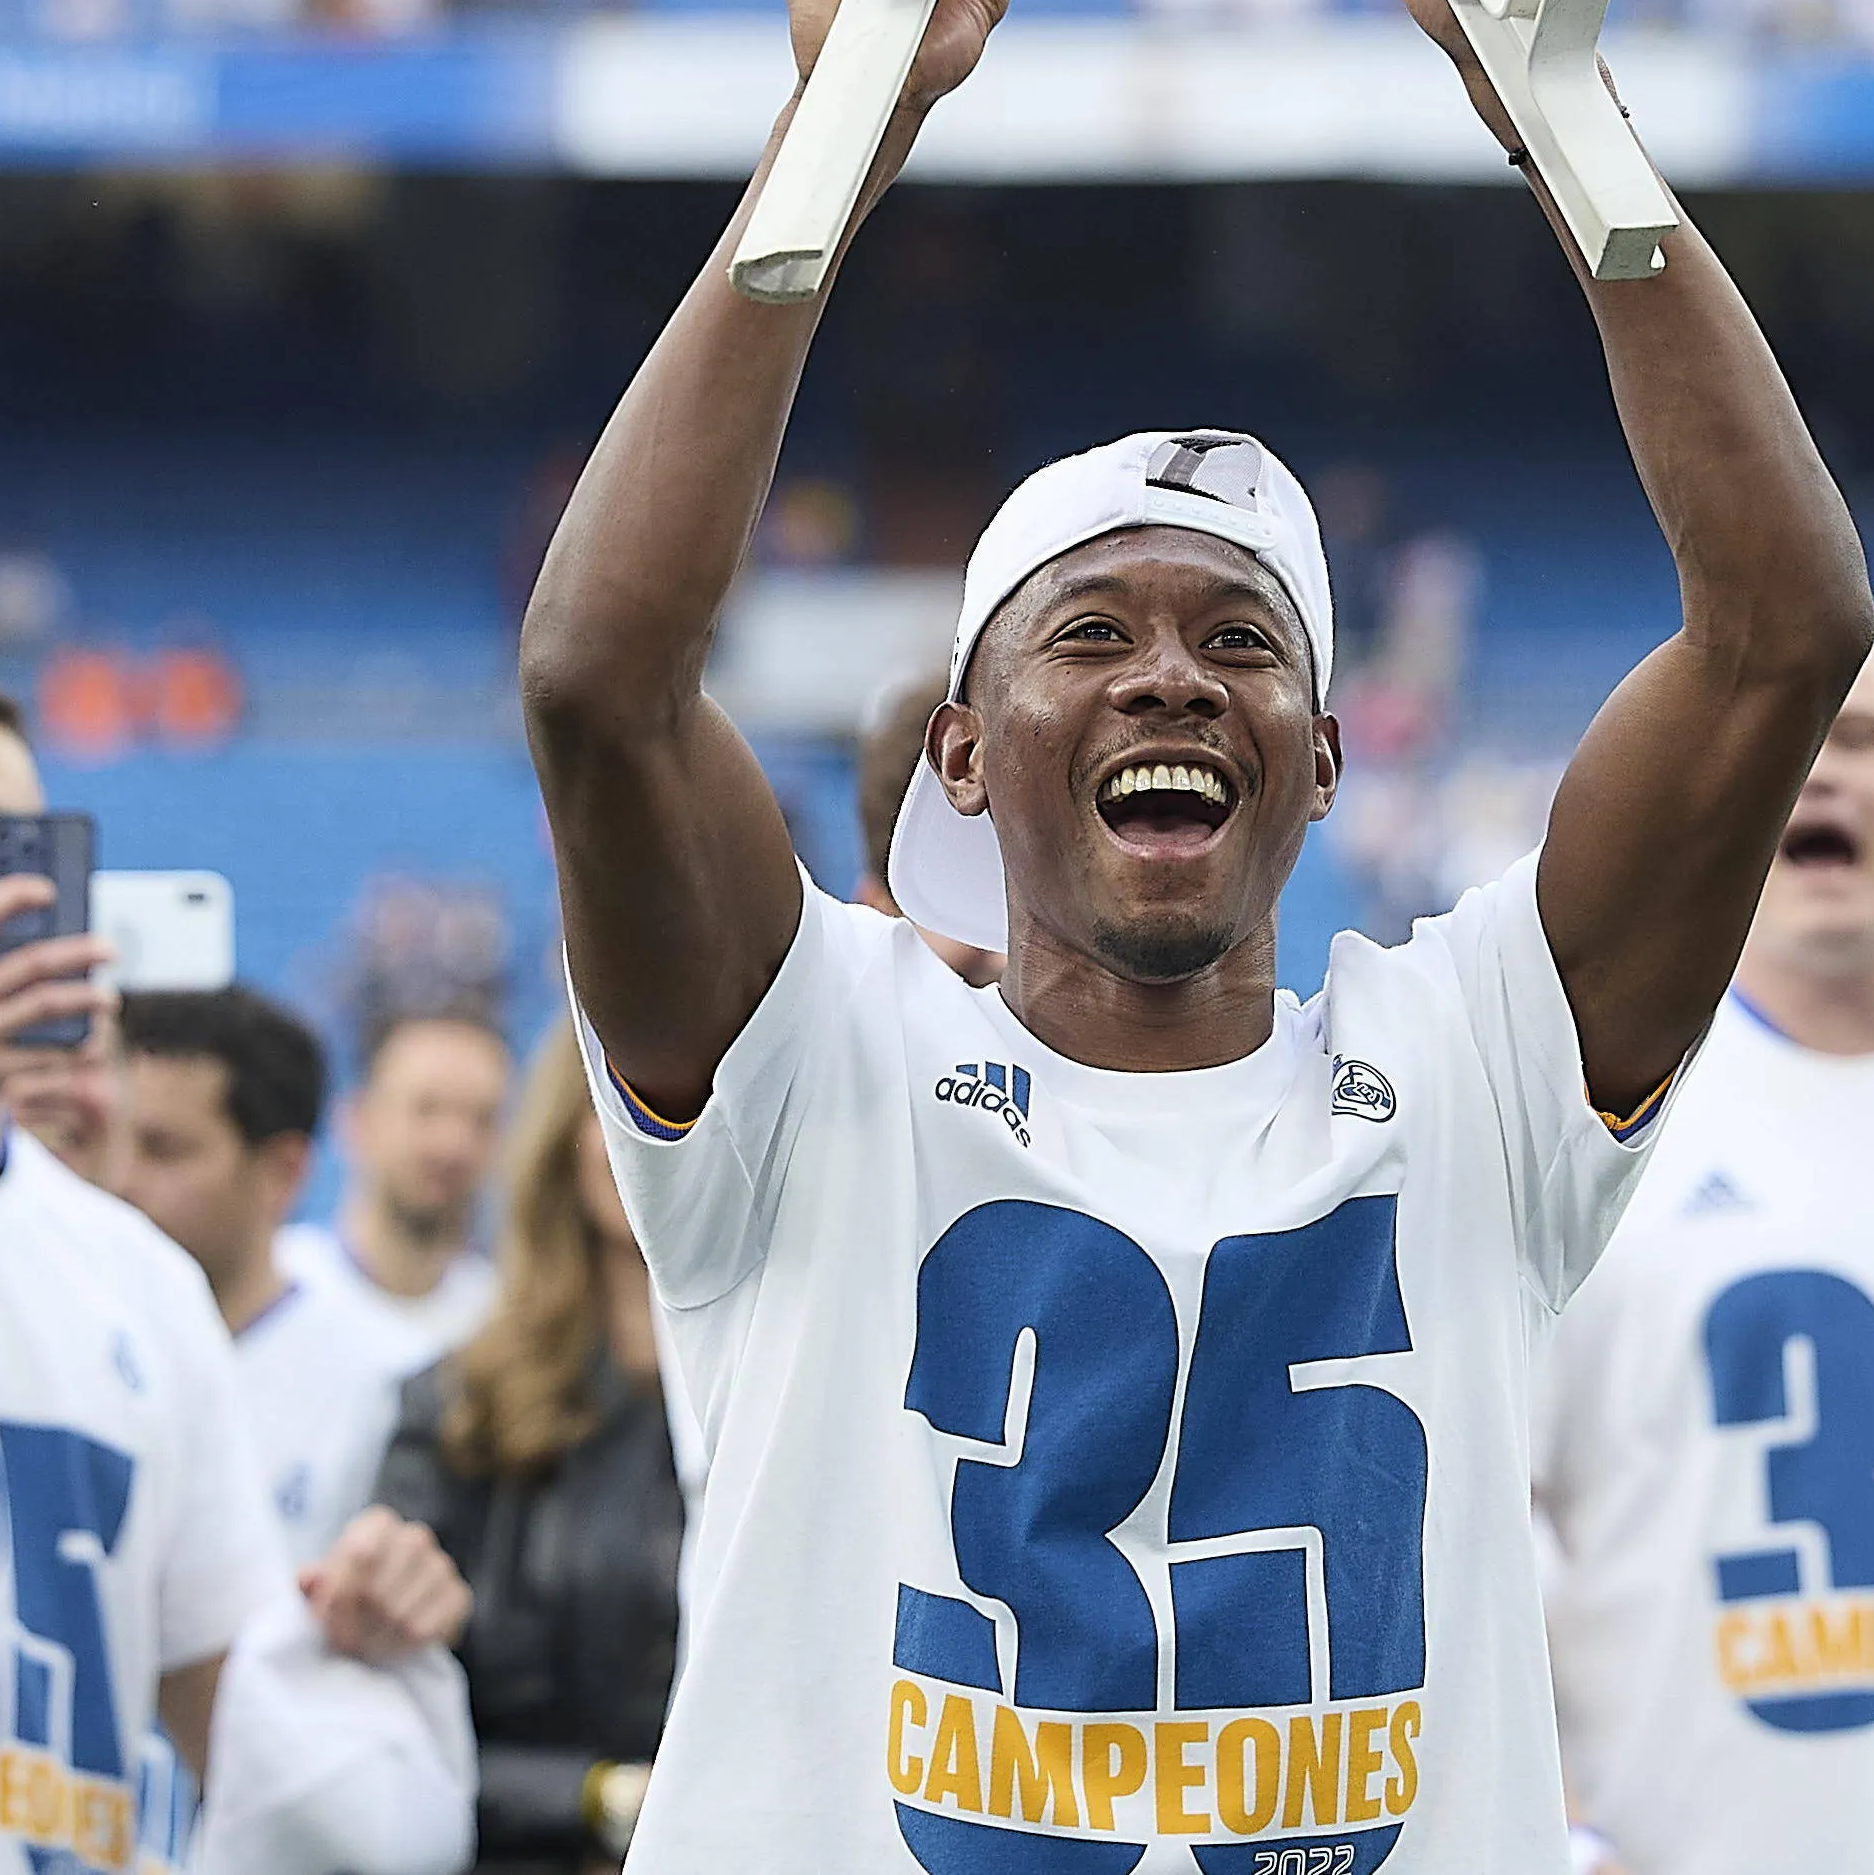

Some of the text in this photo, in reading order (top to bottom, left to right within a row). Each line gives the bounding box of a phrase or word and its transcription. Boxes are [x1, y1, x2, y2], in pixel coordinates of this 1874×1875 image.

[935, 1076, 1031, 1148] adidas
[892, 1193, 1429, 1875] 35
[886, 1679, 1422, 1837] CAMPEONES
